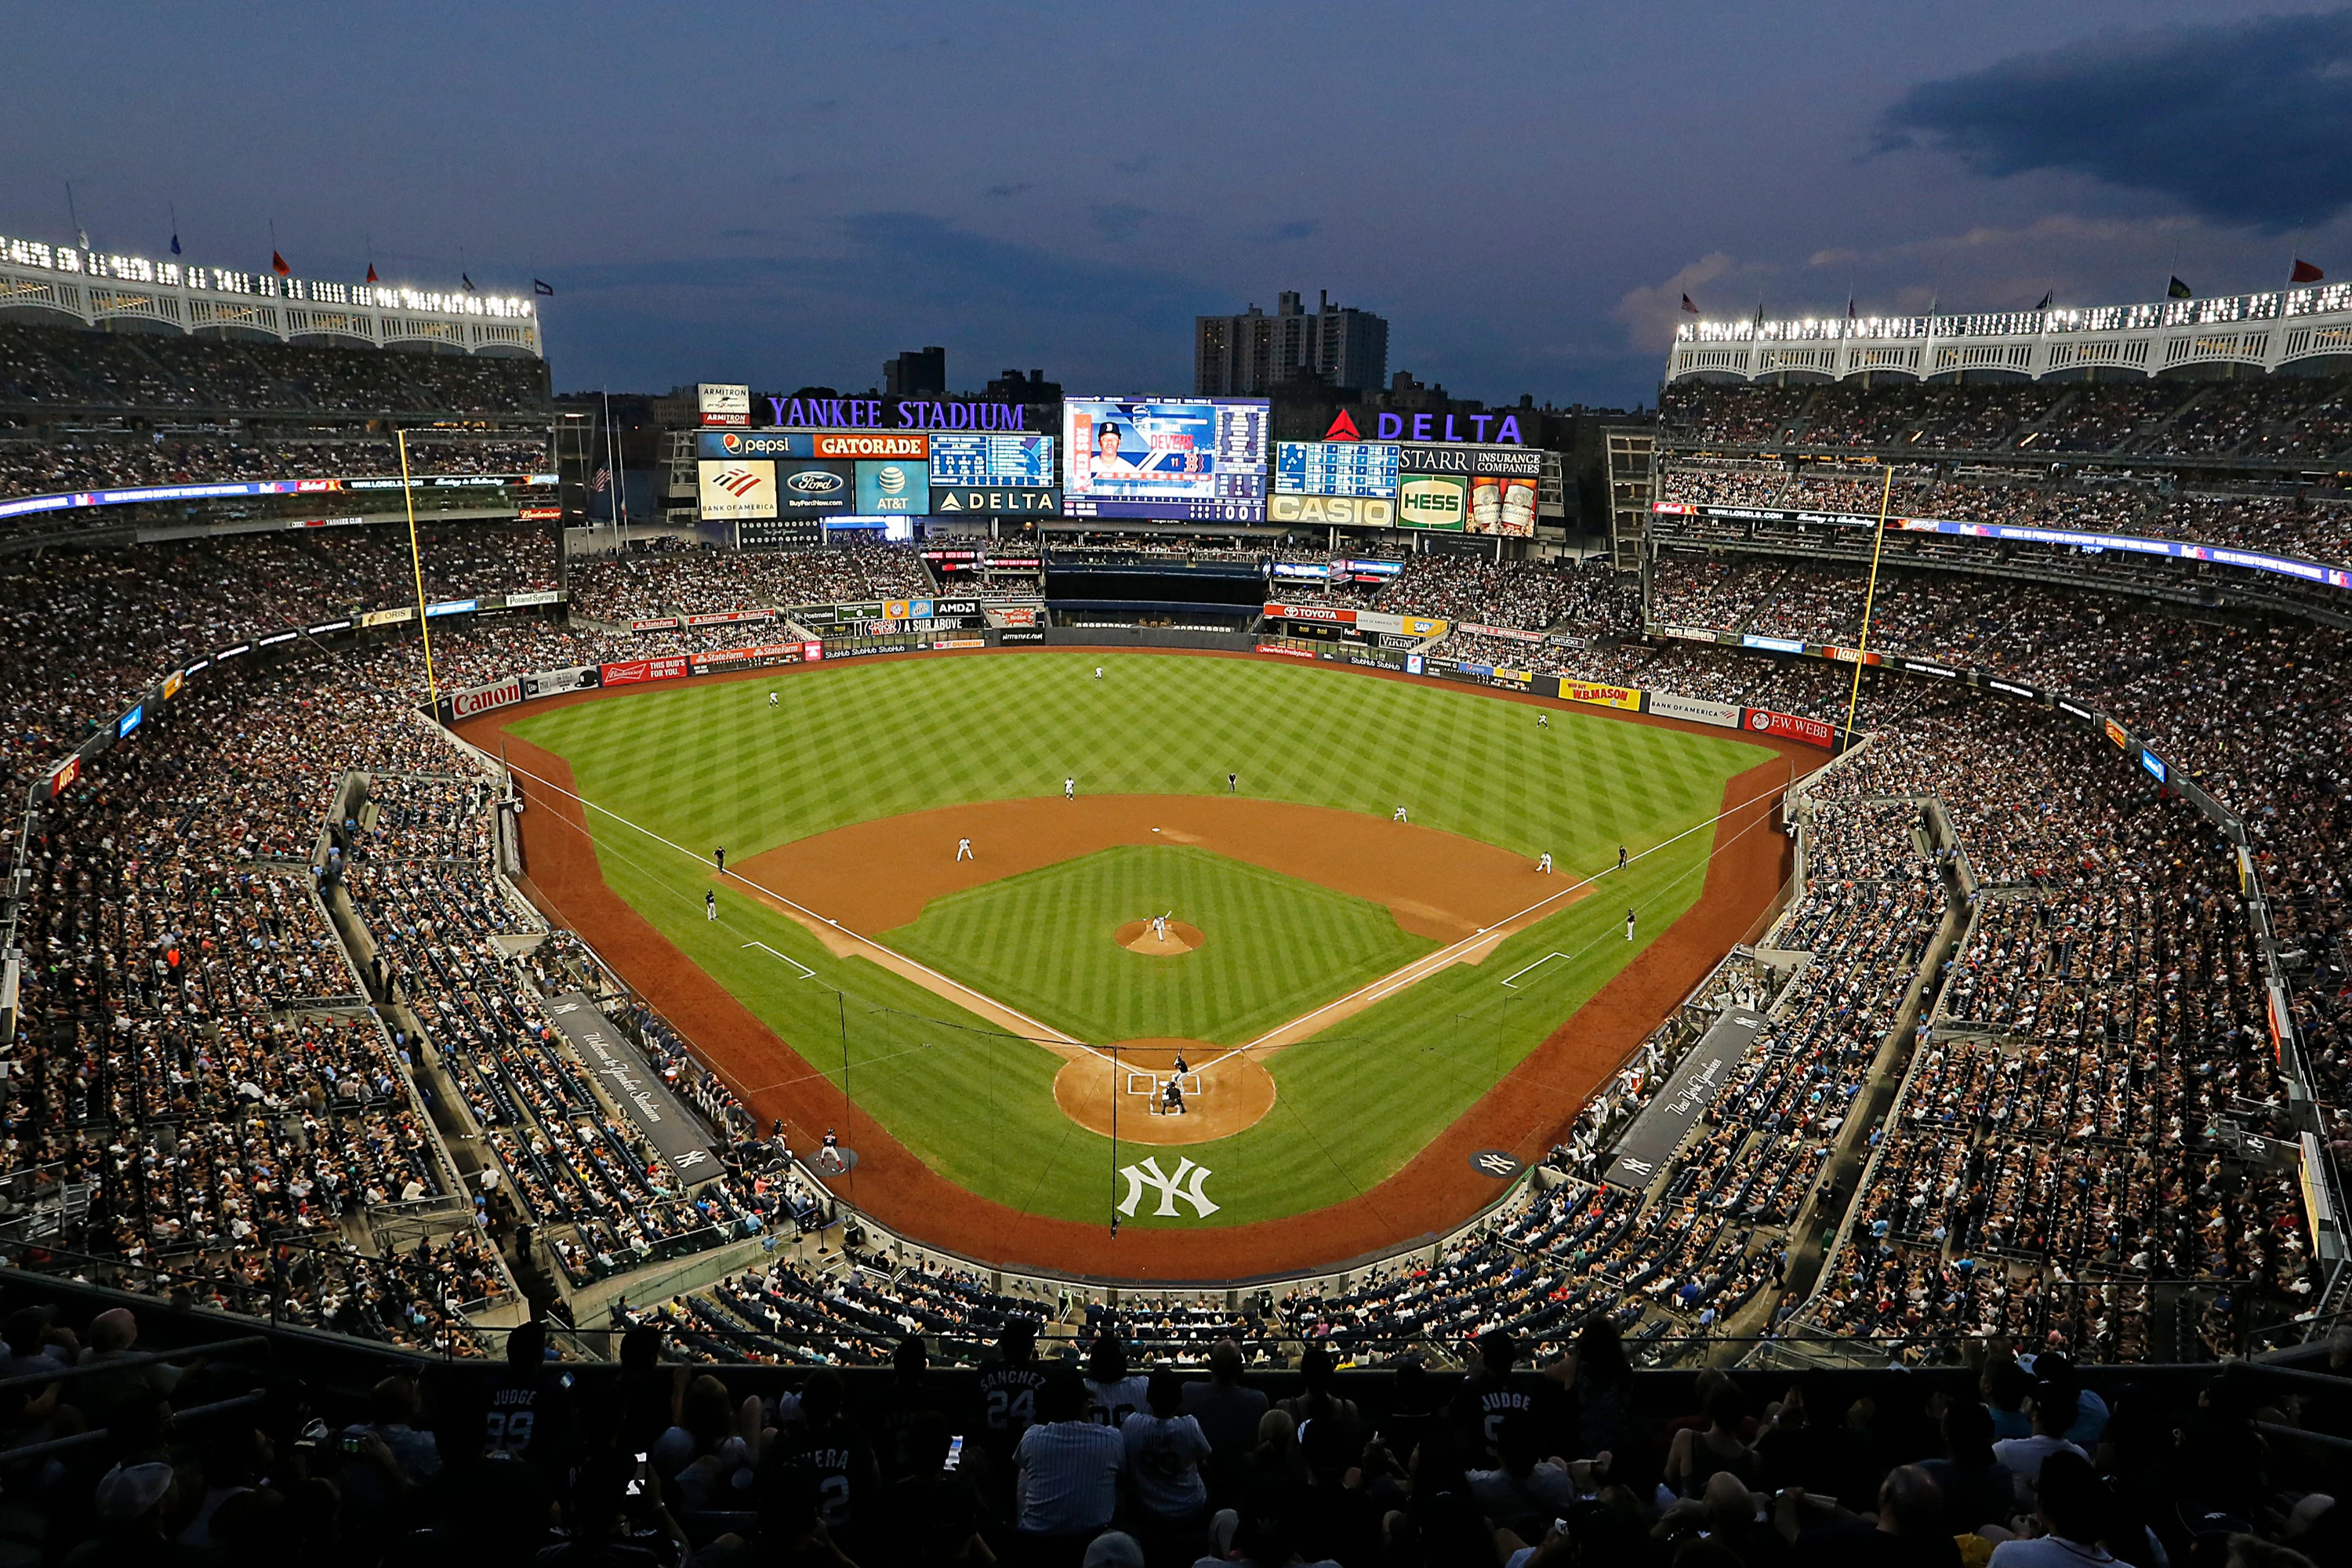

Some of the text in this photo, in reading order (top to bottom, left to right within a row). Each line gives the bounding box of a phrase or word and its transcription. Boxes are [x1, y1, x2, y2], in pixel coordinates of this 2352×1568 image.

[768, 397, 1025, 430] YANKEE STADIUM
[1377, 412, 1523, 444] DELTA
[745, 436, 789, 455] pepsi
[821, 437, 922, 456] GATORADE
[1150, 434, 1194, 451] DEVERS
[1400, 449, 1469, 470] STARR
[1477, 452, 1541, 465] INSURANCE
[1476, 463, 1540, 474] COMPANIES
[798, 471, 833, 491] Ford
[789, 499, 843, 508] BuyFordNow.com
[877, 498, 908, 510] AT&T
[969, 492, 1054, 510] DELTA
[1405, 493, 1458, 511] HESS
[520, 510, 561, 519] Budweiser
[1272, 496, 1392, 525] CASIO
[1708, 509, 1784, 520] WWW.LOBELS.COM
[510, 593, 555, 605] Poland Spring
[385, 609, 406, 619] ORIS
[939, 603, 966, 613] AMD
[1299, 609, 1338, 620] TOYOTA
[904, 618, 963, 632] A SUB ABOVE
[1344, 628, 1361, 637] FedEx
[1414, 622, 1430, 632] SAP
[1497, 630, 1539, 641] MODELLS.com
[1664, 626, 1717, 641] Parts Authority
[1381, 636, 1418, 648] VIKING
[826, 651, 850, 659] StubHub
[851, 648, 877, 656] StubHub
[666, 659, 685, 667] BUD'S
[1351, 657, 1400, 671] StubHub StubHub
[665, 668, 680, 677] YOU.
[454, 684, 520, 716] Canon
[1652, 701, 1671, 710] BANK
[1685, 706, 1718, 717] AMERICA
[1771, 715, 1828, 738] F.W. WEBB
[59, 762, 75, 790] AVIS
[583, 1032, 610, 1061] Welcome
[600, 1063, 641, 1093] Yankee
[630, 1091, 662, 1123] Stadium
[1664, 1058, 1722, 1116] New York Yankees
[1116, 1156, 1221, 1218] NY
[979, 1369, 1047, 1392] SANCHEZ
[493, 1388, 538, 1407] JUDGE
[1481, 1392, 1531, 1412] JUDGE
[985, 1388, 1036, 1429] 24
[485, 1410, 535, 1450] 99
